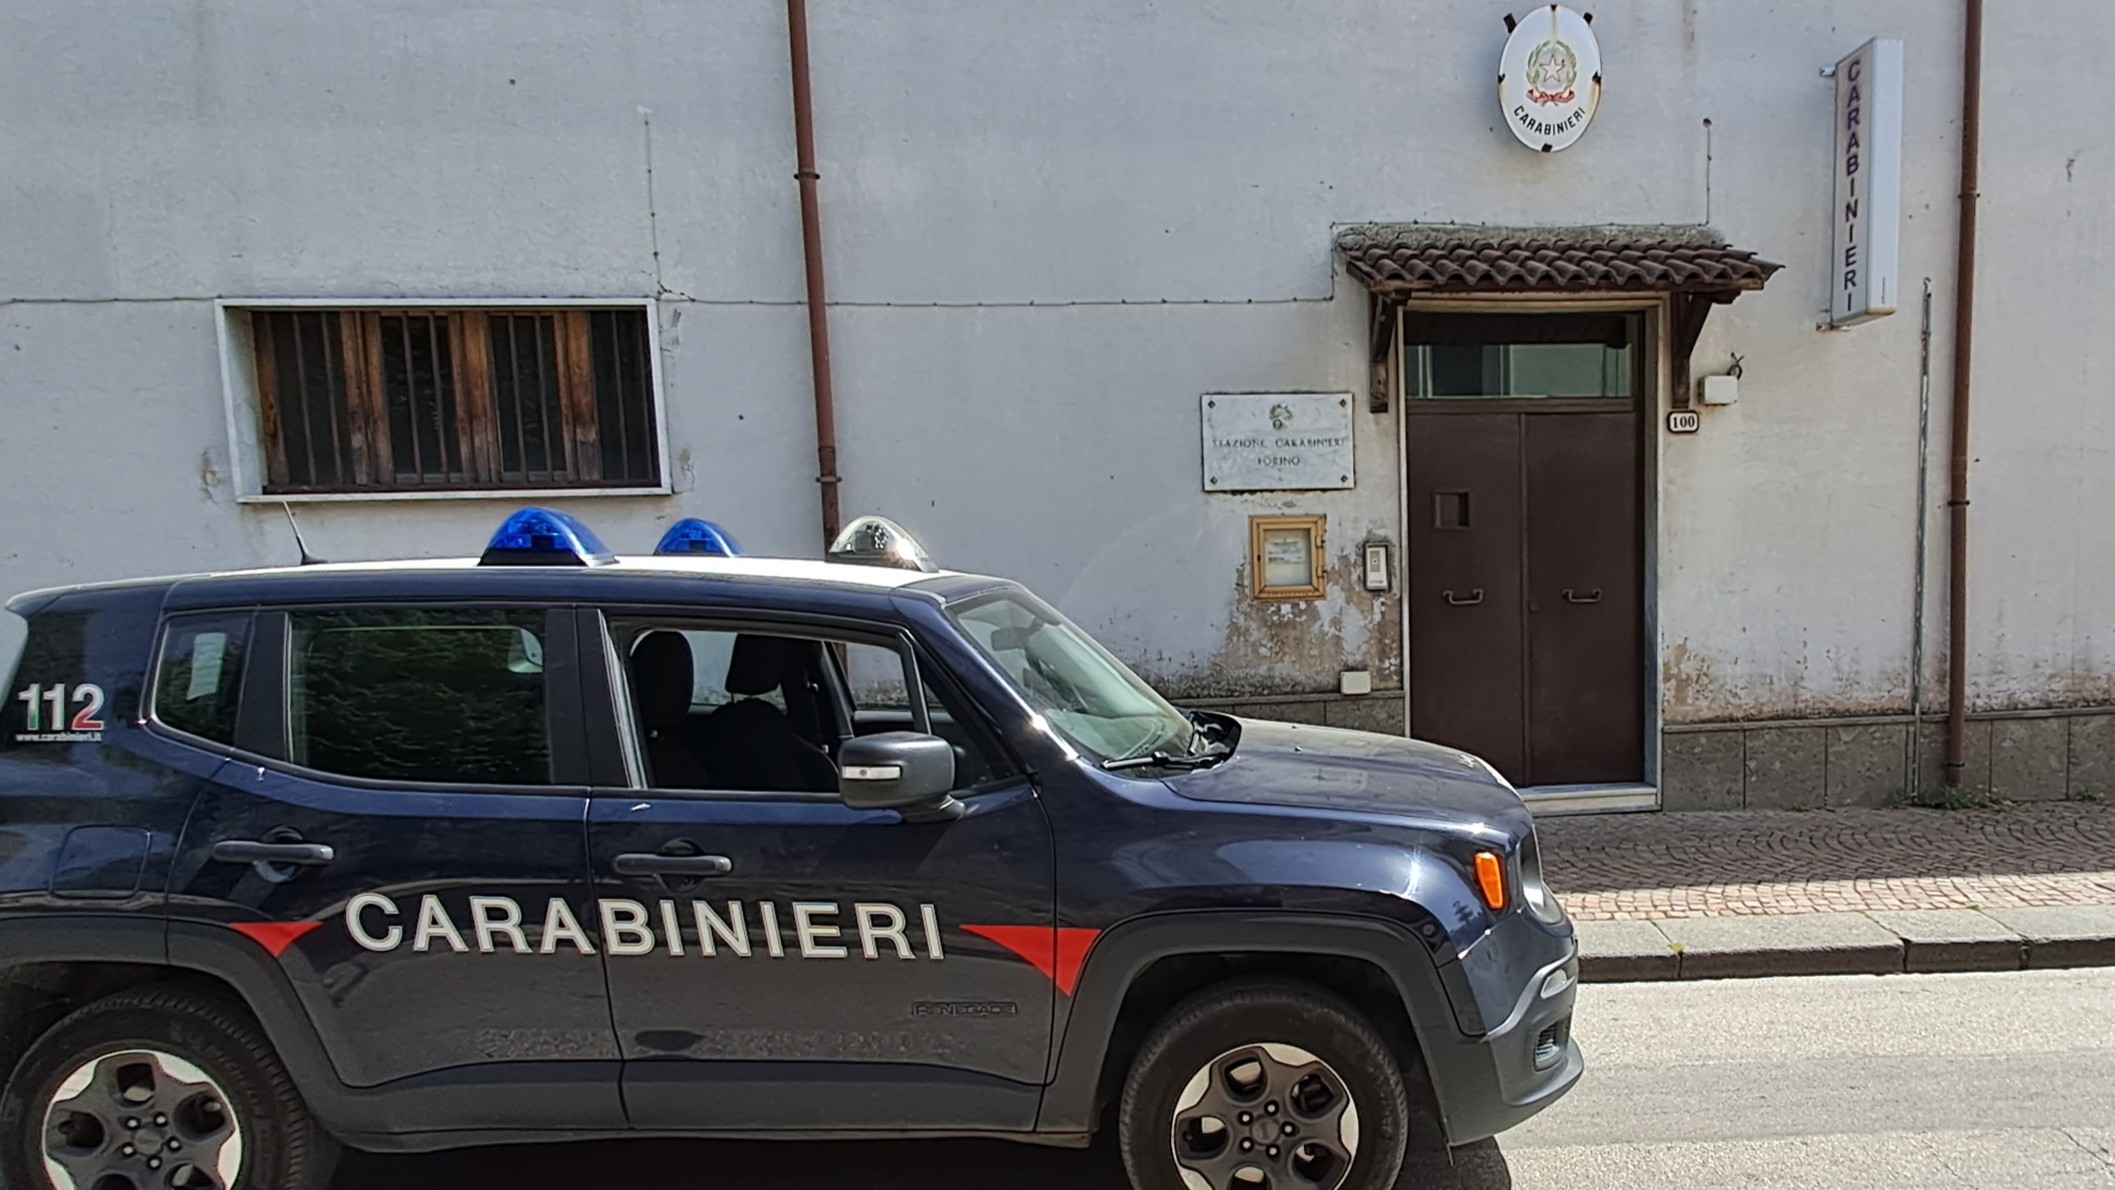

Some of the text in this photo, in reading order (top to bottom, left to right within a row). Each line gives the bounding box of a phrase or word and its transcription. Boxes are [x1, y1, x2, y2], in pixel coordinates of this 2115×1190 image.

[1513, 105, 1586, 136] CARABINIERI
[1844, 59, 1861, 312] CARABINIERI
[1672, 415, 1695, 429] 100
[1212, 437, 1346, 449] STAZIONE CARABINIERI
[17, 683, 105, 731] 112
[344, 891, 944, 961] CARABINIERI
